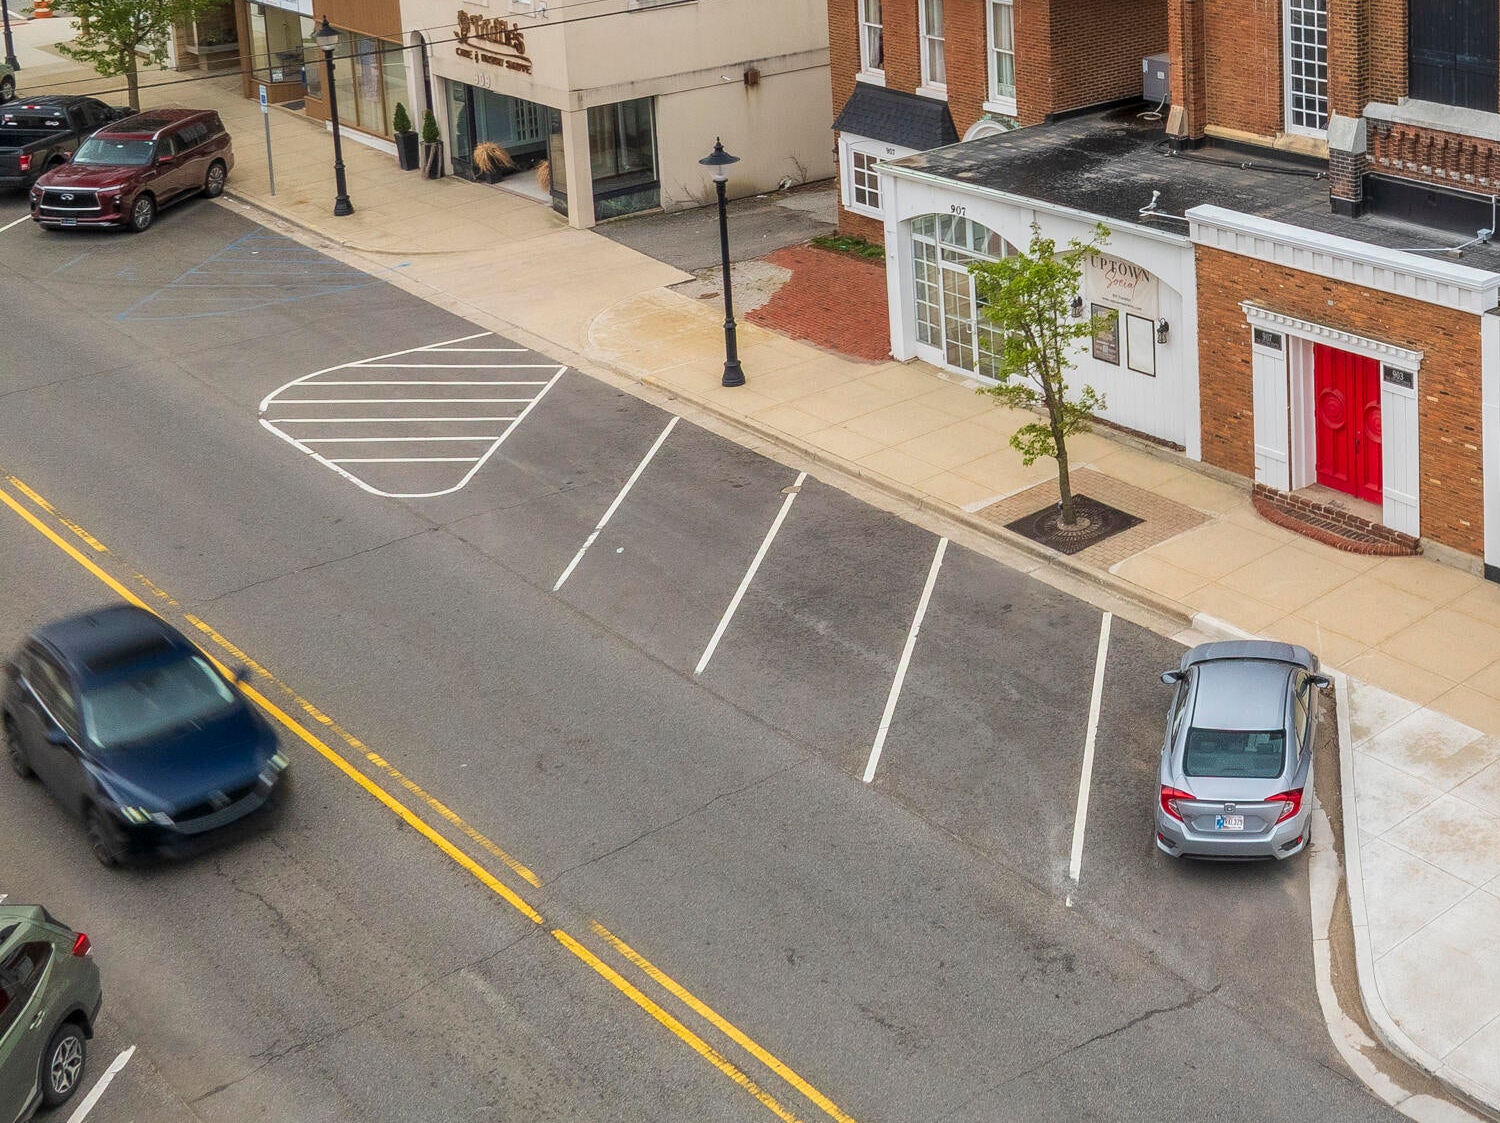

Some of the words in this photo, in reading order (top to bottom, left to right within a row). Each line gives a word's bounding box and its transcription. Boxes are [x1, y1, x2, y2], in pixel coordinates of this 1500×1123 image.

[950, 204, 966, 216] 907
[1090, 254, 1150, 283] UPTOWN
[1105, 267, 1143, 298] Social
